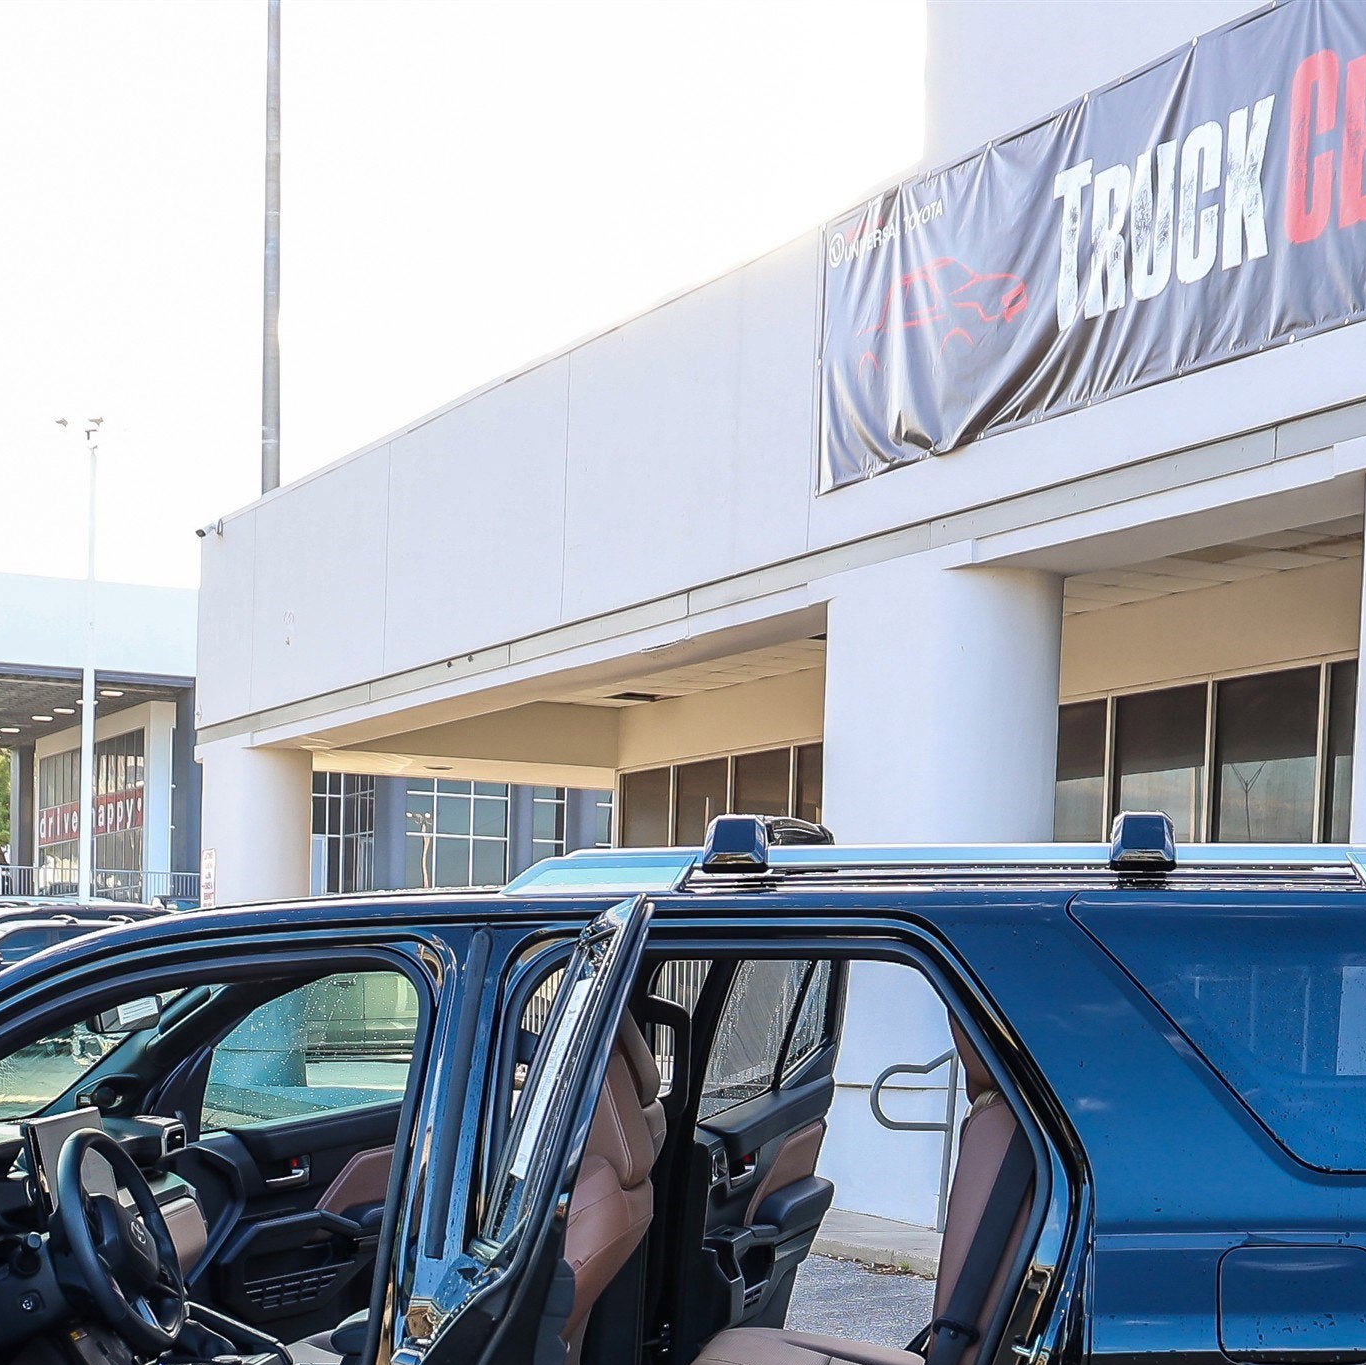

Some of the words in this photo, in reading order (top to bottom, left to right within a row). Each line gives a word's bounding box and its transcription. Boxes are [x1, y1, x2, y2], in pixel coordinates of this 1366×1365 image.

[903, 198, 944, 234] TOYOTA
[1054, 94, 1276, 333] TRUCK
[39, 807, 78, 838] drive
[92, 799, 134, 833] appy
